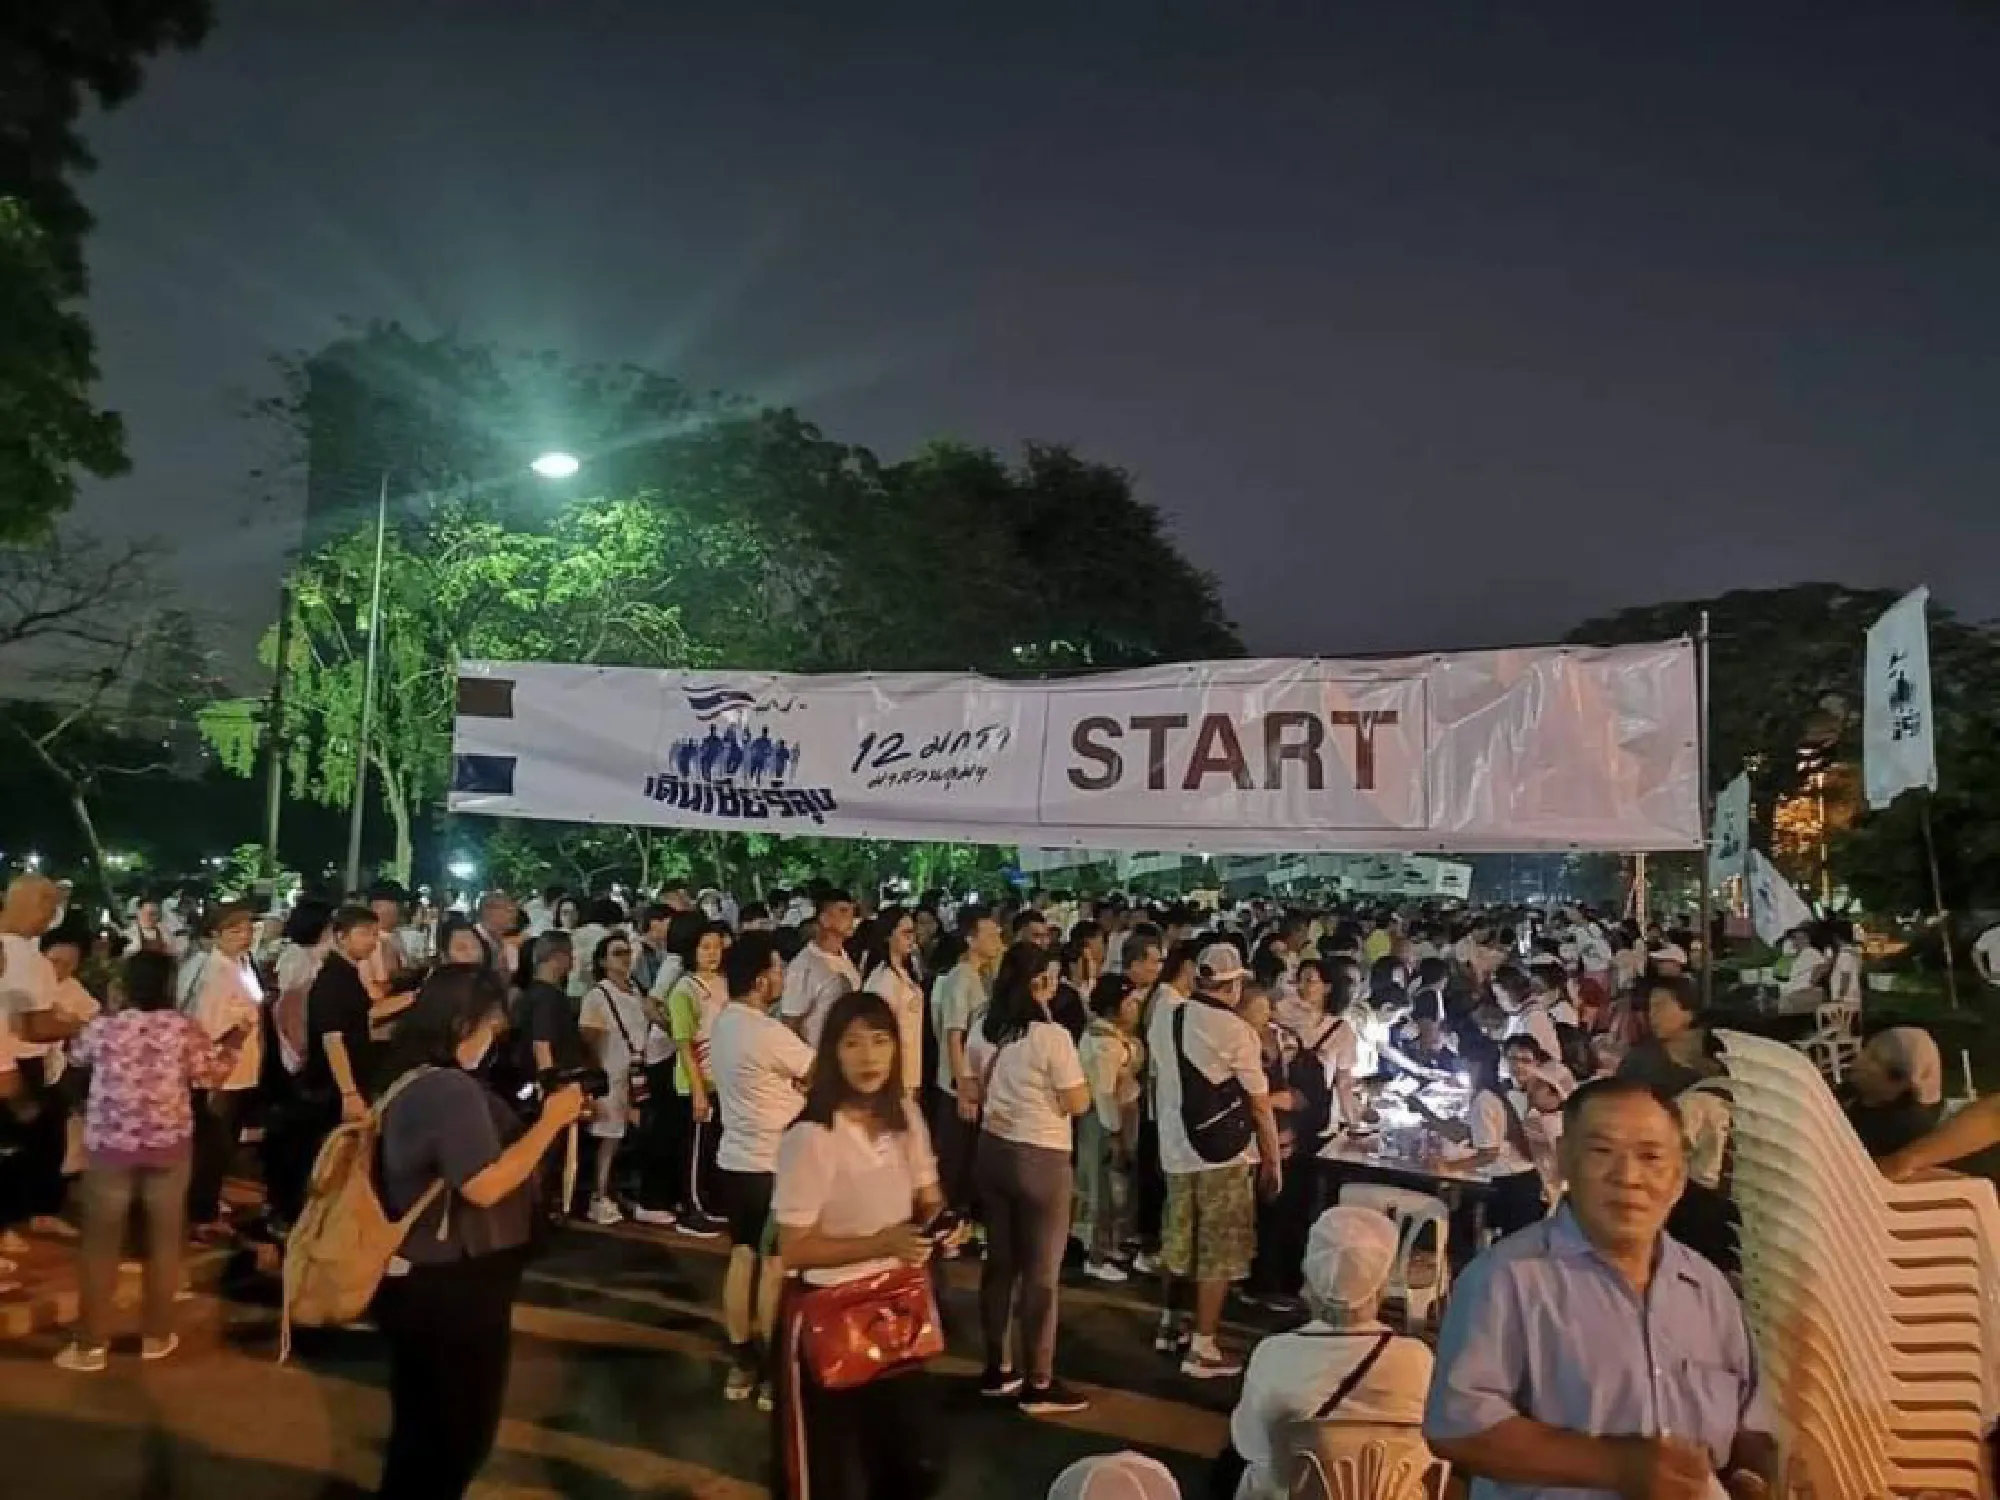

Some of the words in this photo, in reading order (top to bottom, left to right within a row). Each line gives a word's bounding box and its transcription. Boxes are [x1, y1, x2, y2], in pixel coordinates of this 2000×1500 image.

[851, 732, 912, 773] 12
[919, 722, 1012, 759] มกรา
[1067, 710, 1398, 790] START
